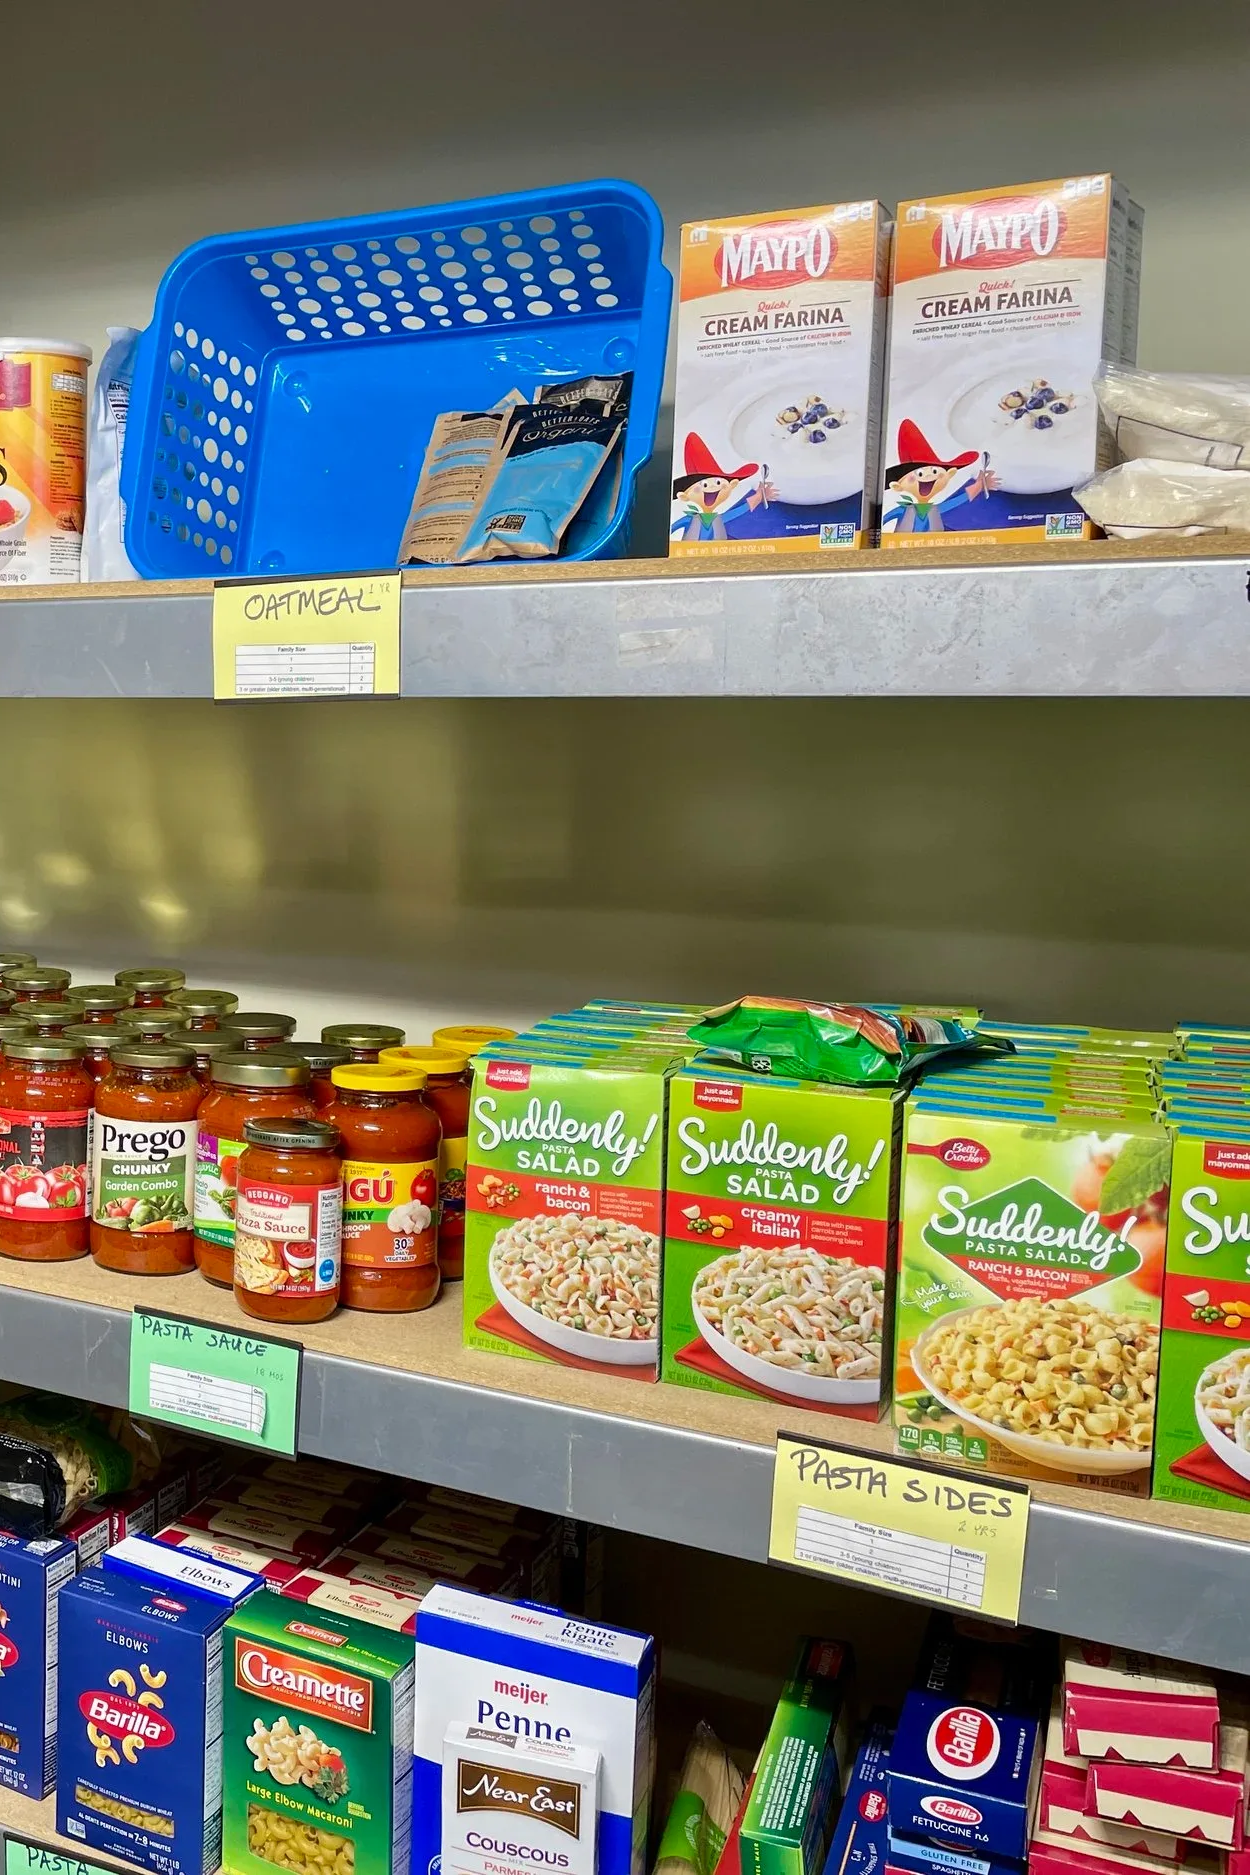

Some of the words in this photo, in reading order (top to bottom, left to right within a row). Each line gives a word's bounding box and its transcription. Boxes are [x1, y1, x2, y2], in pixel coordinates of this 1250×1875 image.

[939, 199, 1059, 268] MAYPO
[721, 225, 831, 288] MAYPO
[978, 280, 1016, 293] Quick!
[758, 300, 791, 313] Quick!
[921, 294, 990, 319] CREAM
[997, 286, 1073, 310] FARINA
[704, 314, 769, 336] CREAM
[773, 307, 844, 329] FARINA
[244, 586, 381, 621] OATMEAL
[697, 1095, 739, 1104] mayonnaise
[704, 1086, 718, 1094] just
[101, 1124, 186, 1163] Prego
[474, 1096, 659, 1176] Suddenly!
[543, 1144, 575, 1154] PASTA
[677, 1116, 885, 1204] Suddenly!
[944, 1150, 984, 1163] Crocker
[952, 1142, 980, 1156] Betty
[1217, 1151, 1235, 1160] just
[112, 1162, 171, 1175] CHUNKY
[517, 1151, 600, 1177] SALAD
[756, 1168, 792, 1180] PASTA
[105, 1178, 139, 1192] Garden
[140, 1178, 179, 1191] Combo
[536, 1183, 576, 1196] ranch
[579, 1186, 590, 1198] &
[727, 1175, 819, 1204] SALAD
[247, 1190, 289, 1205] REGGANO
[546, 1196, 590, 1211] bacon
[238, 1213, 261, 1229] Pizza
[264, 1221, 306, 1234] Sauce
[741, 1208, 800, 1227] creamy
[930, 1186, 1138, 1271] Suddenly!
[752, 1221, 800, 1238] italian
[966, 1241, 1017, 1257] PASTA
[1026, 1248, 1081, 1264] SALAD
[969, 1260, 1012, 1275] RANCH
[1015, 1266, 1022, 1276] &
[1026, 1268, 1070, 1282] BACON
[140, 1315, 194, 1342] PASTA
[206, 1334, 268, 1357] SAUCE
[901, 1427, 918, 1439] 170
[790, 1449, 887, 1498] PASTA
[902, 1479, 1012, 1518] SIDES
[855, 1523, 876, 1534] Family
[878, 1528, 892, 1538] Size
[954, 1548, 983, 1561] Quantity
[180, 1566, 233, 1589] Elbows
[141, 1605, 179, 1622] ELBOWS
[326, 1593, 350, 1605] Elbow
[350, 1601, 394, 1620] Macaroni
[510, 1613, 544, 1627] meijer
[106, 1630, 149, 1654] ELBOWS
[289, 1622, 343, 1644] Creamette
[561, 1628, 615, 1648] Rigate
[565, 1622, 617, 1641] Penne
[240, 1649, 365, 1711] Creamette
[494, 1679, 547, 1704] meijer
[89, 1698, 161, 1740] Barilla
[477, 1700, 571, 1742] Penne
[469, 1730, 495, 1739] Near
[496, 1734, 515, 1743] East
[943, 1711, 982, 1764] Barilla
[246, 1780, 272, 1799] Large
[275, 1792, 304, 1811] Elbow
[307, 1806, 353, 1828] Macaroni
[463, 1773, 529, 1804] Near
[530, 1786, 575, 1813] East
[934, 1801, 978, 1822] Barilla
[912, 1815, 972, 1838] FETTUCCINE
[975, 1832, 990, 1842] n.6
[26, 1845, 89, 1875] PASTA
[466, 1831, 569, 1867] COUSCOUS
[921, 1849, 958, 1864] GLUTEN
[961, 1858, 984, 1870] FREE
